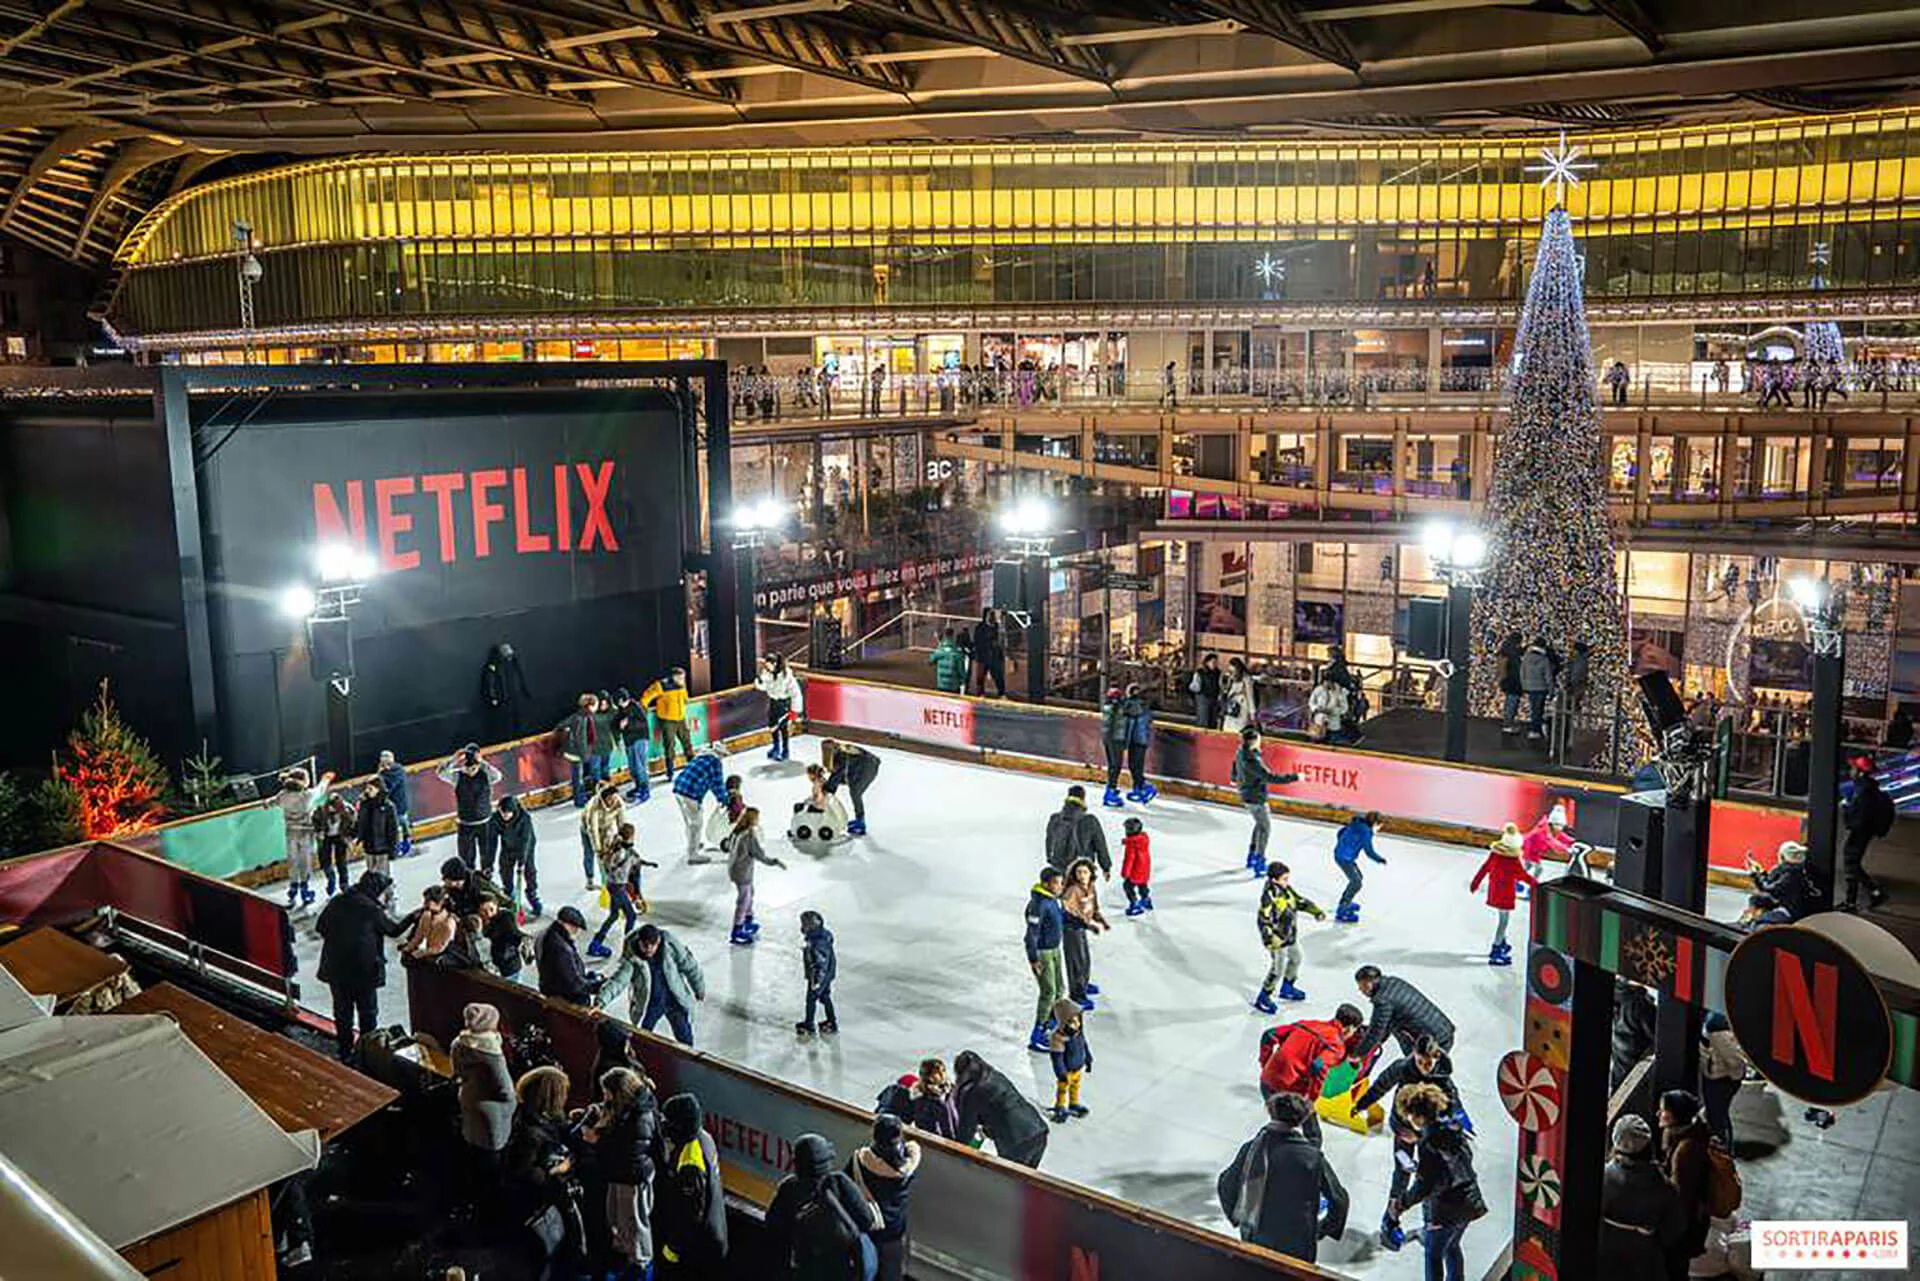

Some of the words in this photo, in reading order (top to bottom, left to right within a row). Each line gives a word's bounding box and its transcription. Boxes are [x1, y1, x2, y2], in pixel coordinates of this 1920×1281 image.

[312, 460, 619, 571] NETFLIX
[808, 580, 834, 601] que
[837, 573, 868, 591] vous
[1771, 947, 1839, 1082] N
